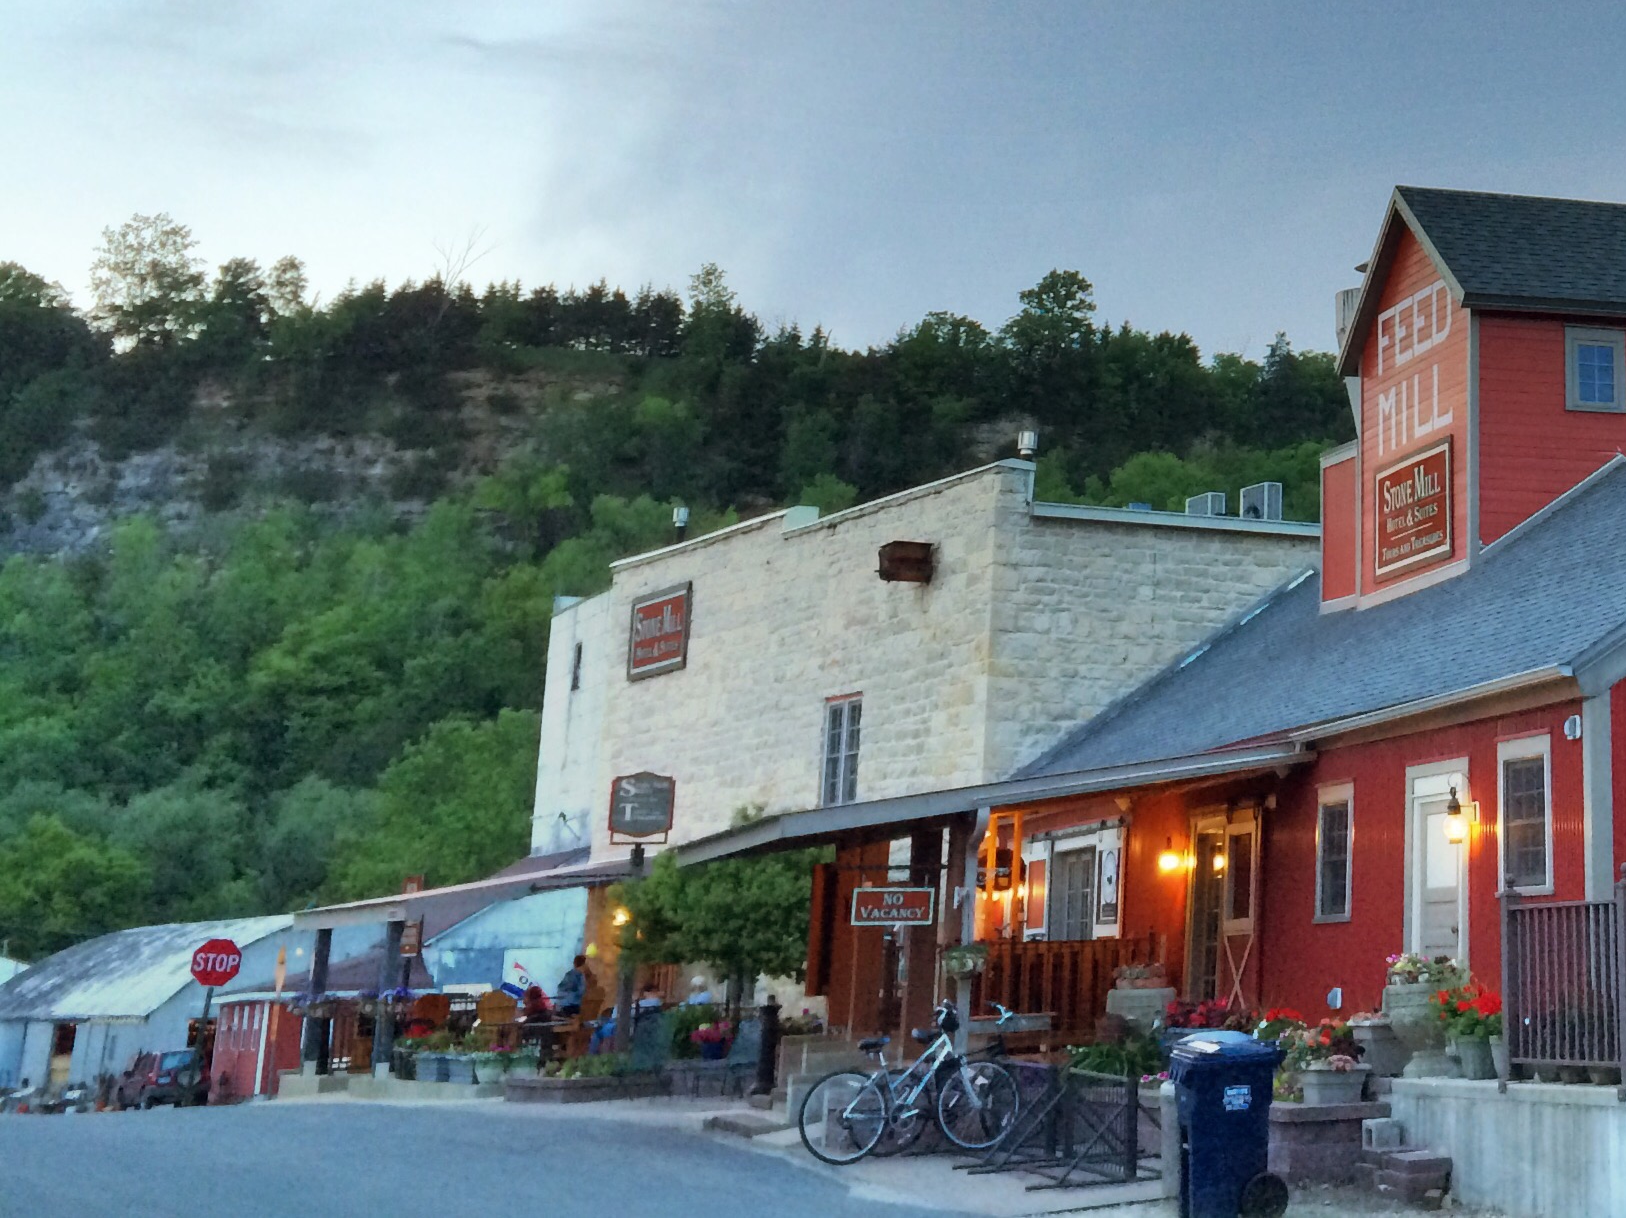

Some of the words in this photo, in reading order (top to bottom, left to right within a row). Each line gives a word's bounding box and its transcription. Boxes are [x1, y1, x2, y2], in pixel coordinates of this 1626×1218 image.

[1377, 278, 1452, 377] FEED
[1378, 363, 1454, 457] MILL
[1383, 479, 1413, 515] STONE
[1414, 464, 1441, 502] MILL
[1406, 508, 1414, 527] &
[1414, 502, 1438, 523] SUITES
[634, 613, 662, 642] STONE
[663, 604, 683, 634] MILL
[861, 904, 926, 919] VACANCY
[883, 893, 904, 906] NO
[193, 952, 240, 973] STOP
